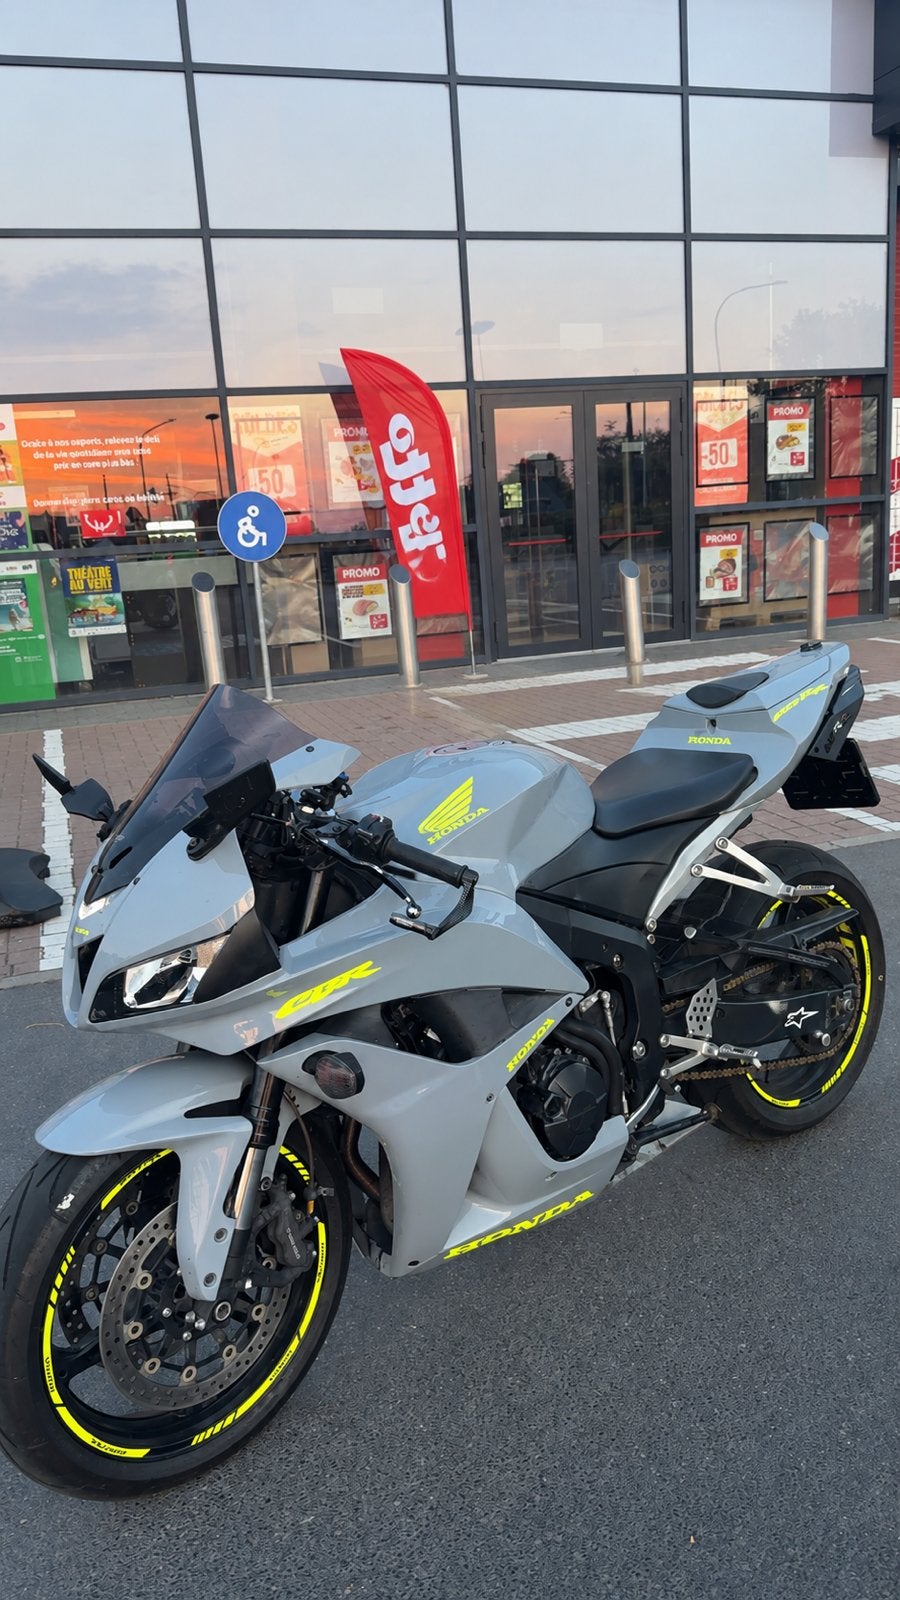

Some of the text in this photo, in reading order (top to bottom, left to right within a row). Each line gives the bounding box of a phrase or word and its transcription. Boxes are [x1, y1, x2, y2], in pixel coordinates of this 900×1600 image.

[773, 406, 804, 417] PROMO
[705, 533, 738, 543] PROMO
[342, 567, 380, 579] PROMO
[426, 807, 490, 846] HONDA
[443, 1189, 594, 1261] HONDA
